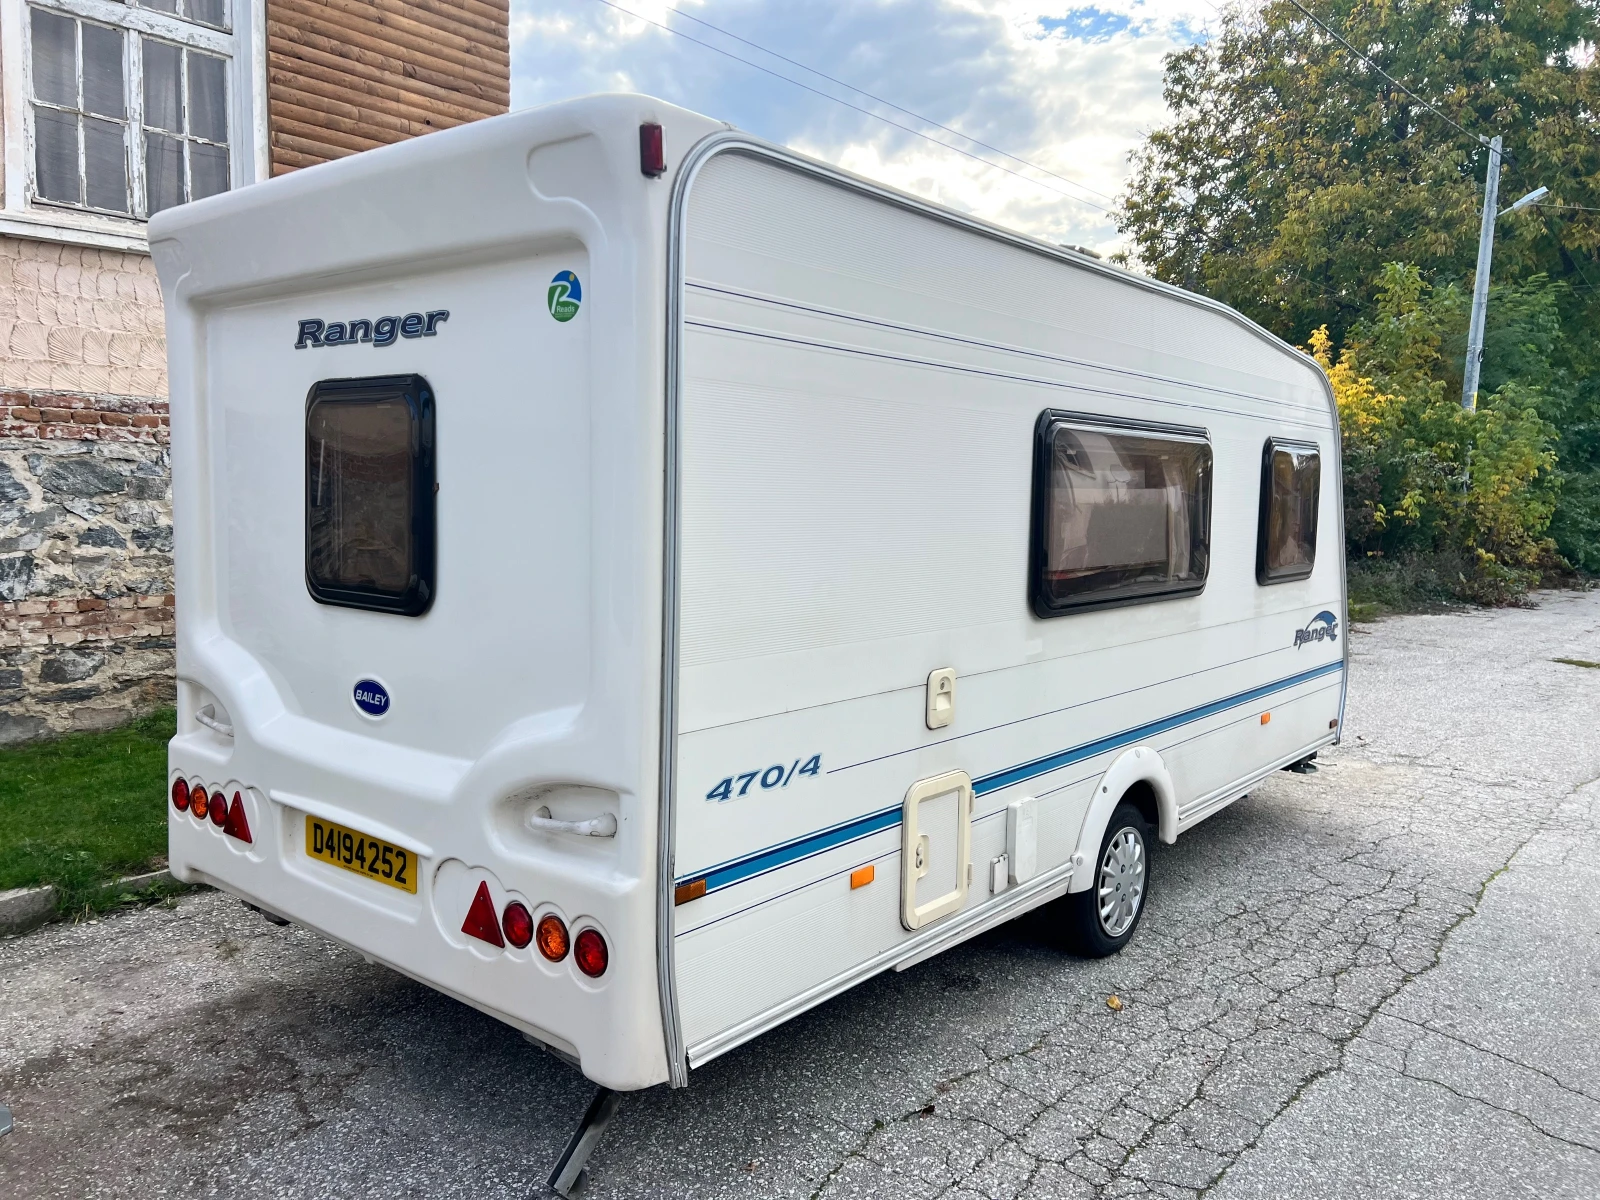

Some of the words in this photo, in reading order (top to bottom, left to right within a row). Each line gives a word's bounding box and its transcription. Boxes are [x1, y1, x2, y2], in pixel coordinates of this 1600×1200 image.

[556, 304, 576, 313] Reads
[295, 309, 449, 349] Ranger
[1293, 622, 1339, 647] Ranger
[355, 689, 387, 706] BAILEY
[705, 752, 822, 802] 470/4
[313, 822, 407, 885] D4194252
